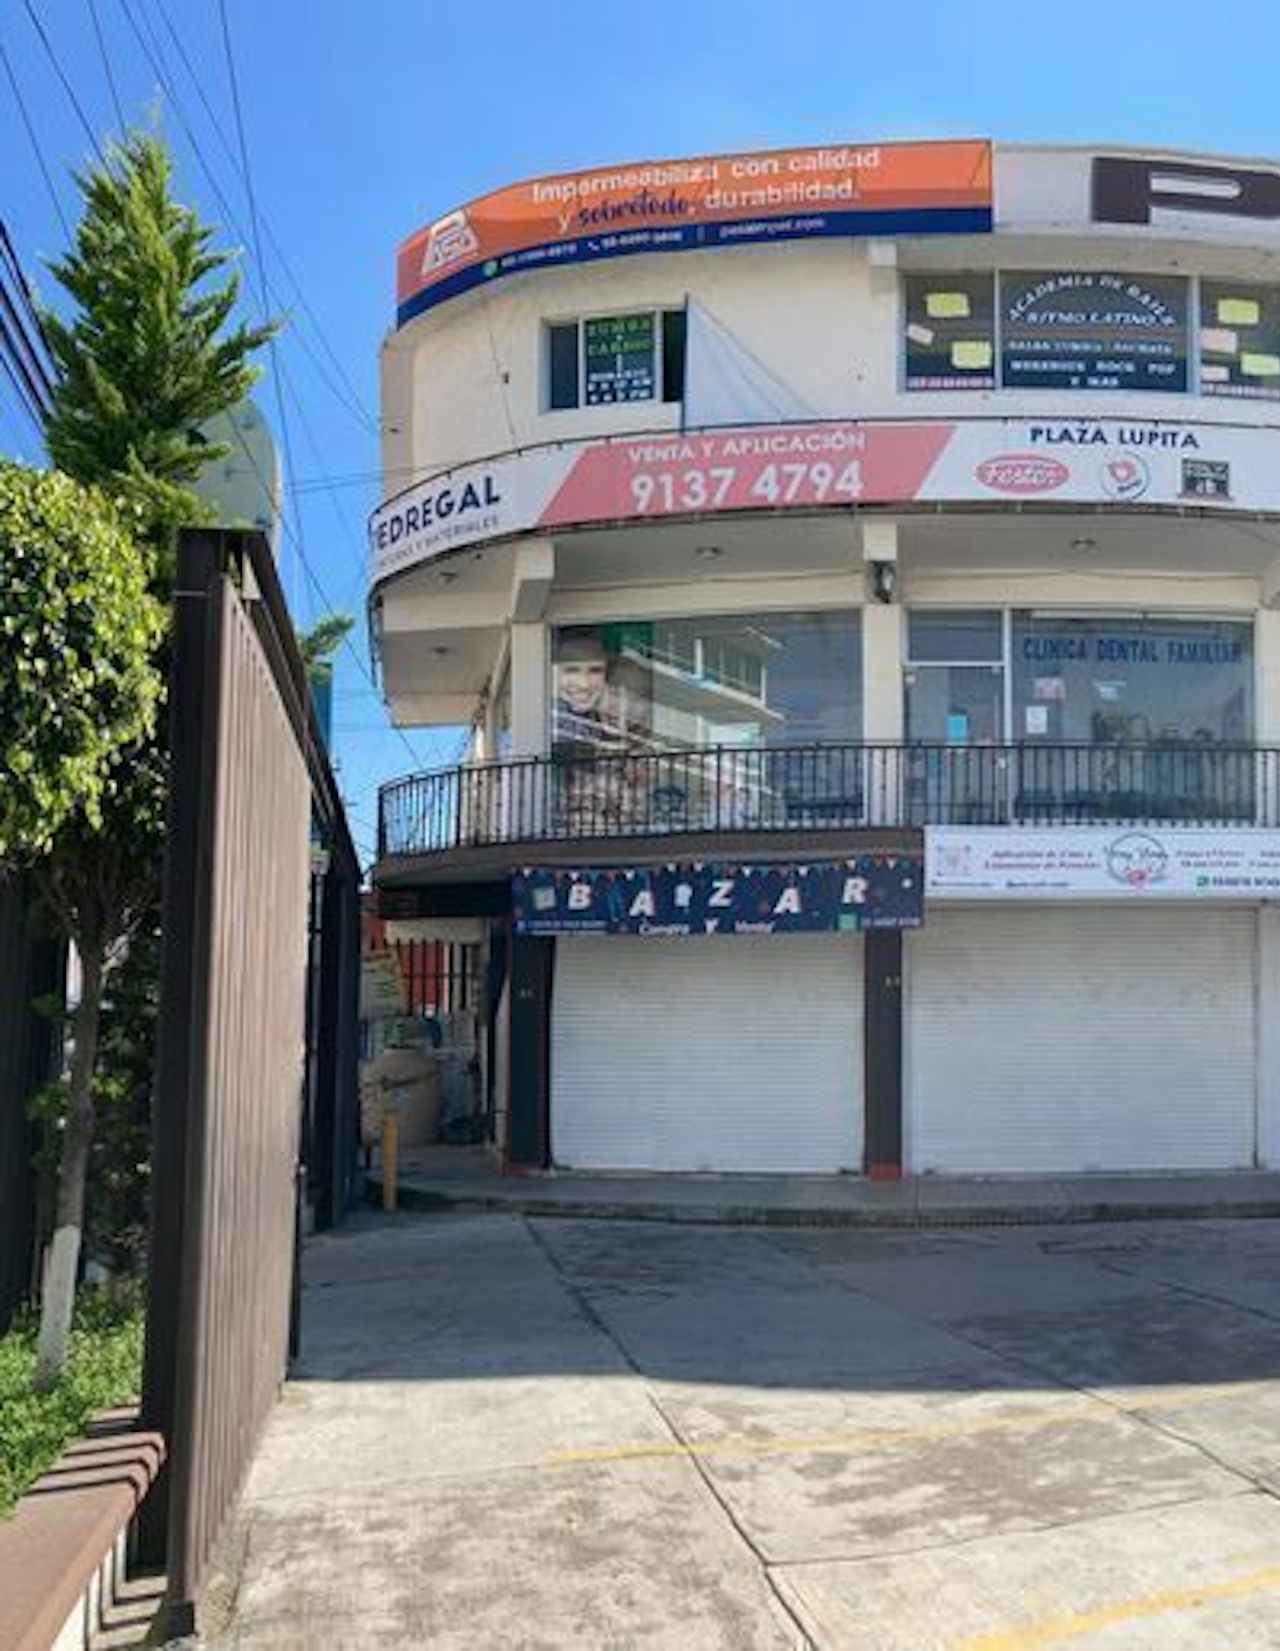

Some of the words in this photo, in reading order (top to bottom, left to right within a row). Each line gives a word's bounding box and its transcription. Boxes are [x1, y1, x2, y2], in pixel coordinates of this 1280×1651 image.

[731, 157, 779, 178] con
[789, 148, 881, 172] calidad
[1029, 427, 1108, 445] PLAZA
[1117, 428, 1200, 449] LUPITA
[370, 476, 501, 550] EDREGAL
[628, 446, 696, 463] VENTA
[702, 441, 715, 457] Y
[722, 429, 866, 456] APLICACIÓN
[630, 467, 736, 513] 9137
[751, 459, 865, 503] 4794
[1097, 639, 1158, 663] DENTAL
